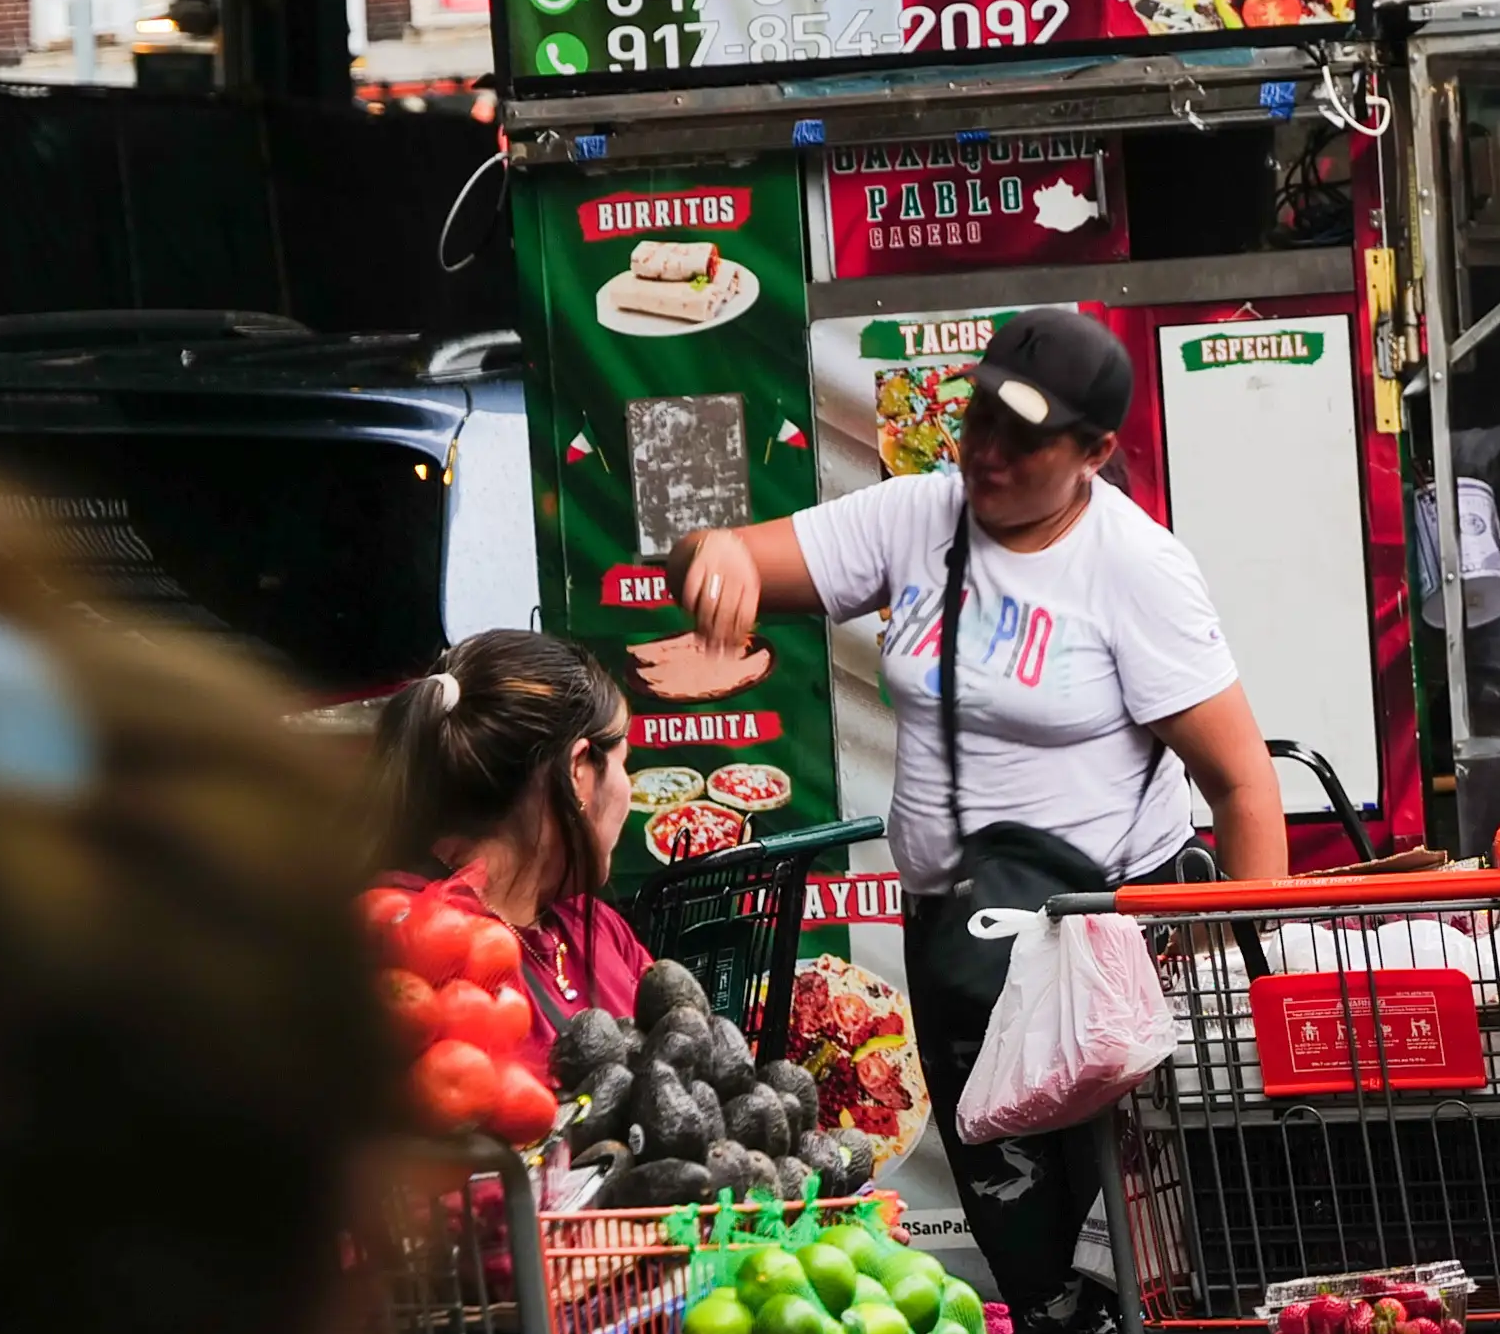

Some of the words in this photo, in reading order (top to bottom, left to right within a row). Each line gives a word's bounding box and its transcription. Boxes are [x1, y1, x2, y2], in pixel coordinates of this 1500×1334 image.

[598, 194, 735, 232] BURRITOS
[865, 175, 1025, 223] PABLO
[898, 319, 994, 357] TACOS
[1200, 333, 1310, 364] ESPECIAL
[619, 575, 674, 603] EMP
[644, 713, 759, 744] PICADITA
[803, 879, 902, 920] AYUD
